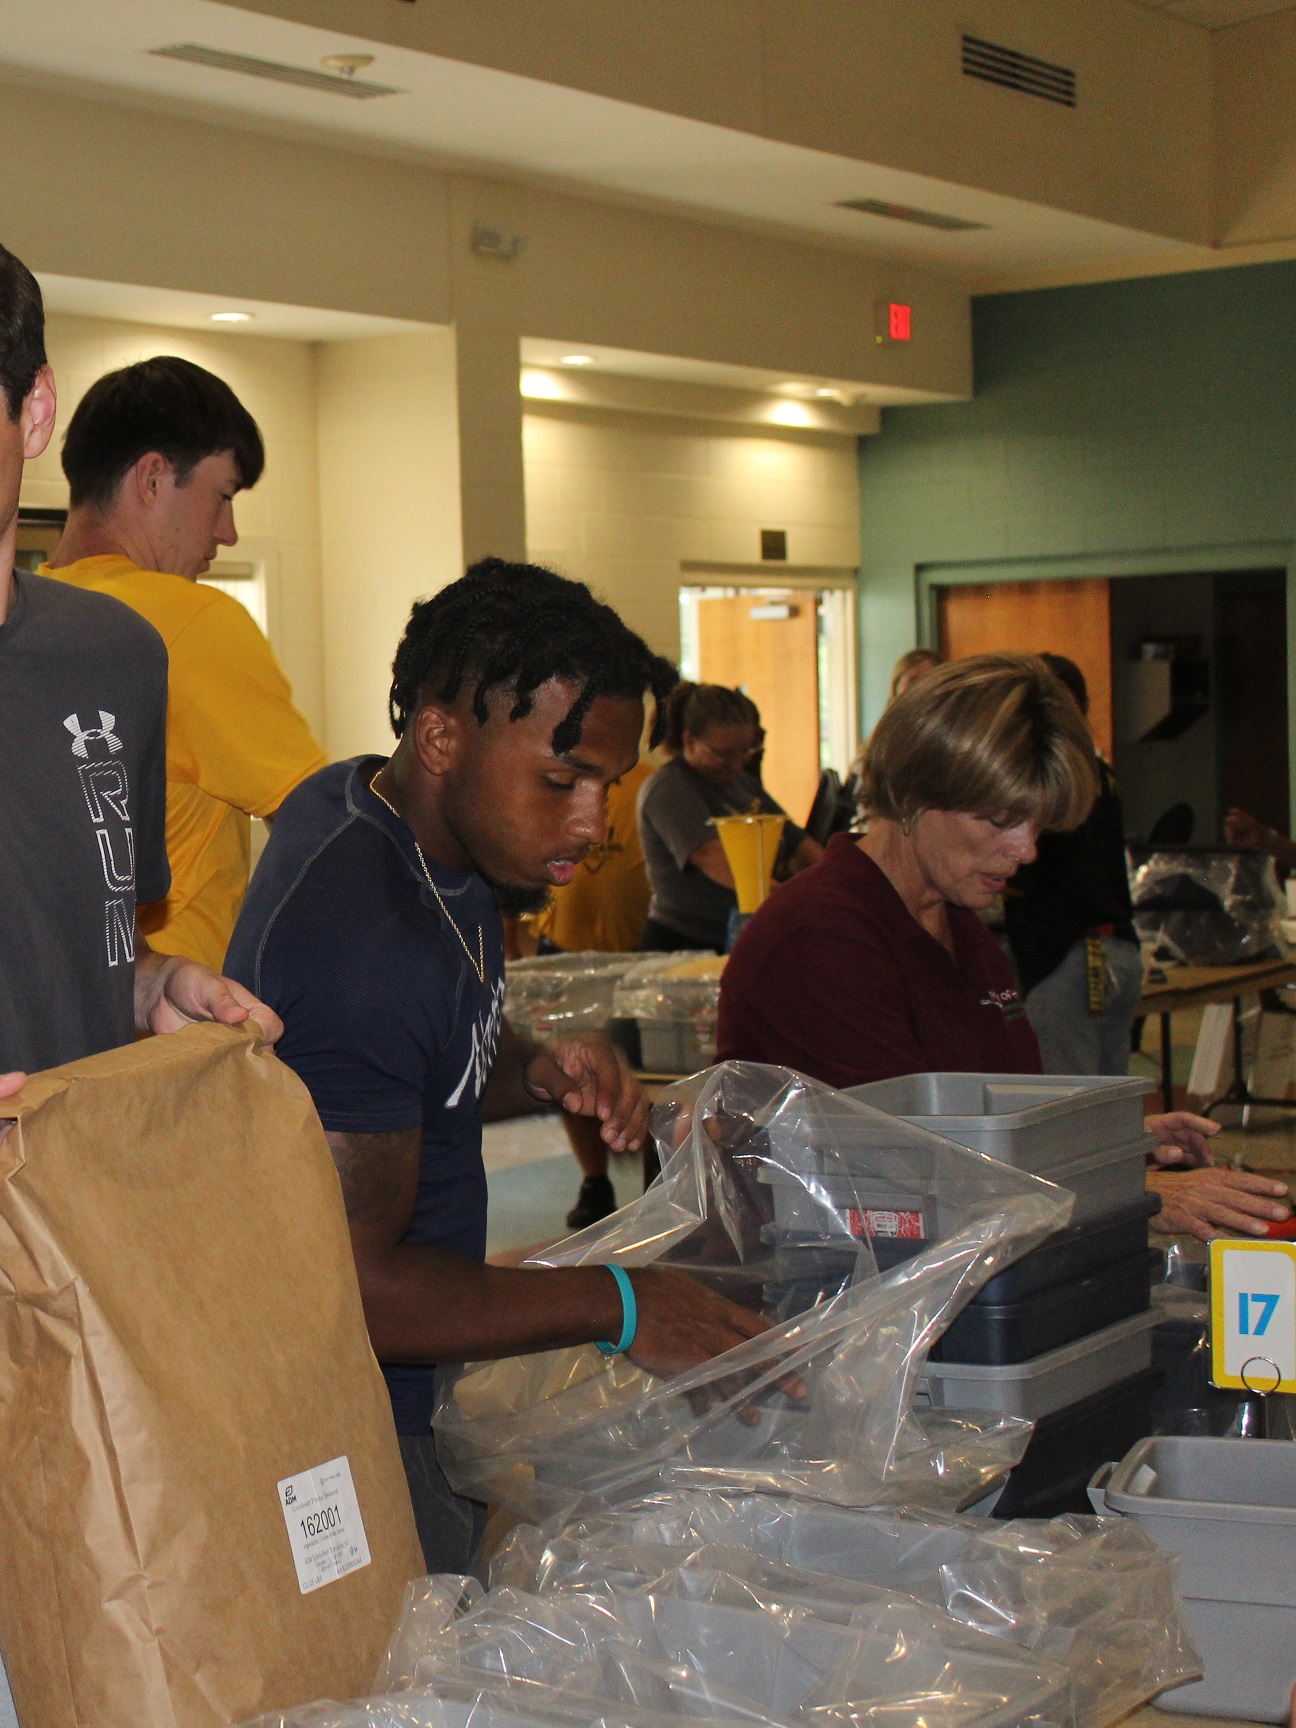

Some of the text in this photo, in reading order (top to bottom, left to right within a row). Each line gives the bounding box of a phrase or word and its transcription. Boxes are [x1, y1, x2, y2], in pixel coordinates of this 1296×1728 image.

[77, 759, 136, 967] RUN
[1238, 1292, 1281, 1336] 17
[285, 1495, 297, 1506] ADM
[300, 1504, 342, 1539] 162001
